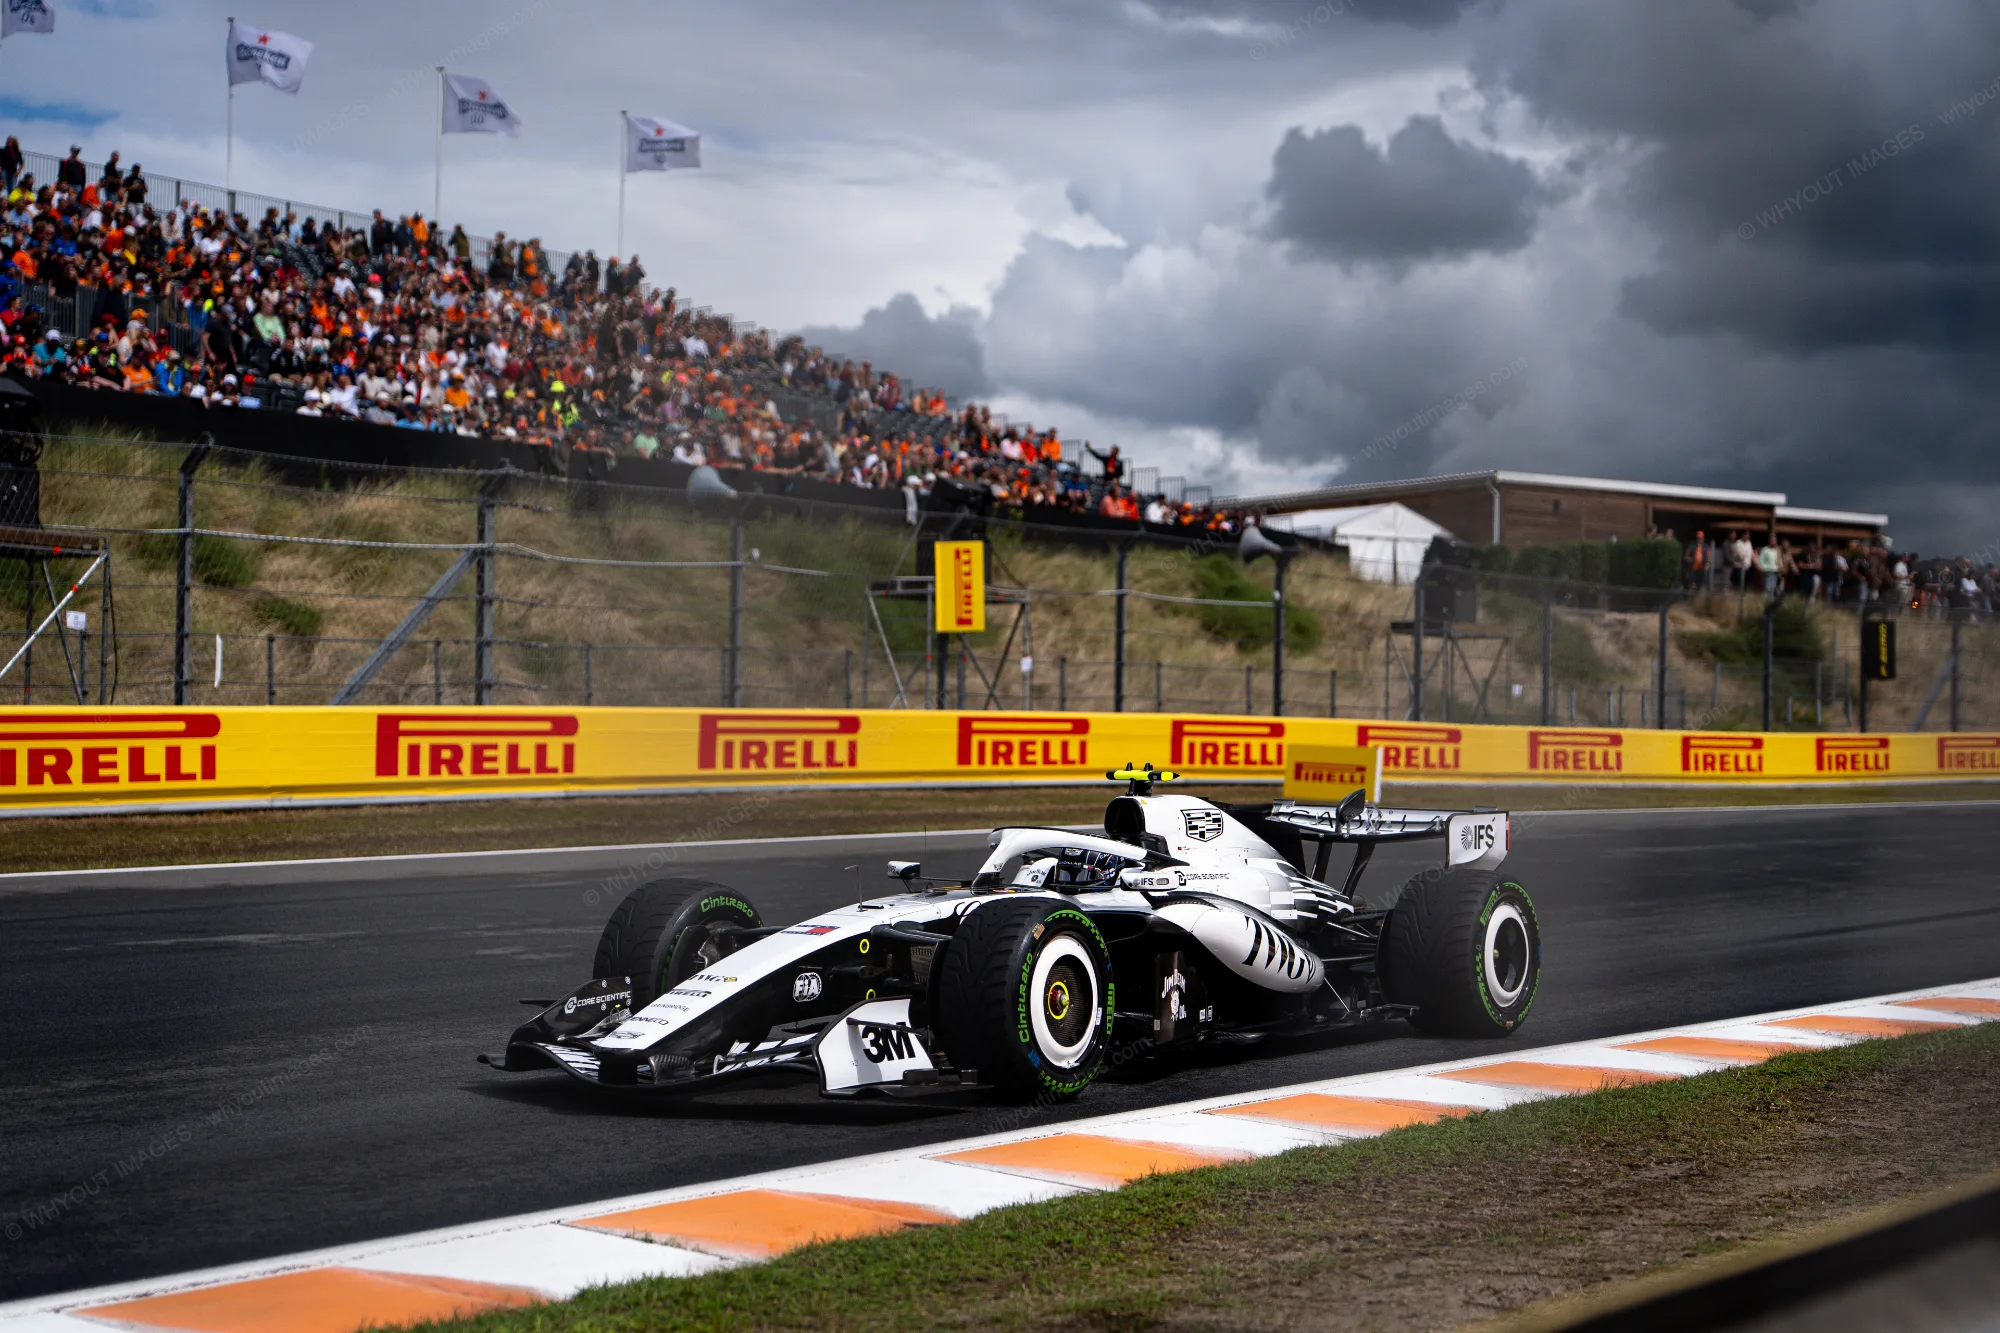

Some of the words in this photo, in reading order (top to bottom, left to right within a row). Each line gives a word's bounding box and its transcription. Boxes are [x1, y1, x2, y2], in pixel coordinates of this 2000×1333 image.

[954, 548, 972, 625] PIRELLI
[376, 714, 578, 776] PIRELLI
[699, 715, 860, 769] PIRELLI
[957, 717, 1090, 767] PIRELLI
[1171, 719, 1285, 767] PIRELLI
[1358, 725, 1461, 769] PRELLI
[1530, 730, 1622, 771] PIRELLI
[1680, 735, 1764, 773] PIRELLI
[1815, 737, 1890, 772] PIRELLI
[1294, 761, 1367, 784] PIRELLI
[1474, 824, 1495, 850] IFS
[1140, 878, 1154, 886] IFS
[577, 997, 596, 1007] CORE
[596, 991, 631, 1004] SCIENTIFIC
[630, 1016, 669, 1026] ENNECO
[861, 1022, 916, 1064] 3M
